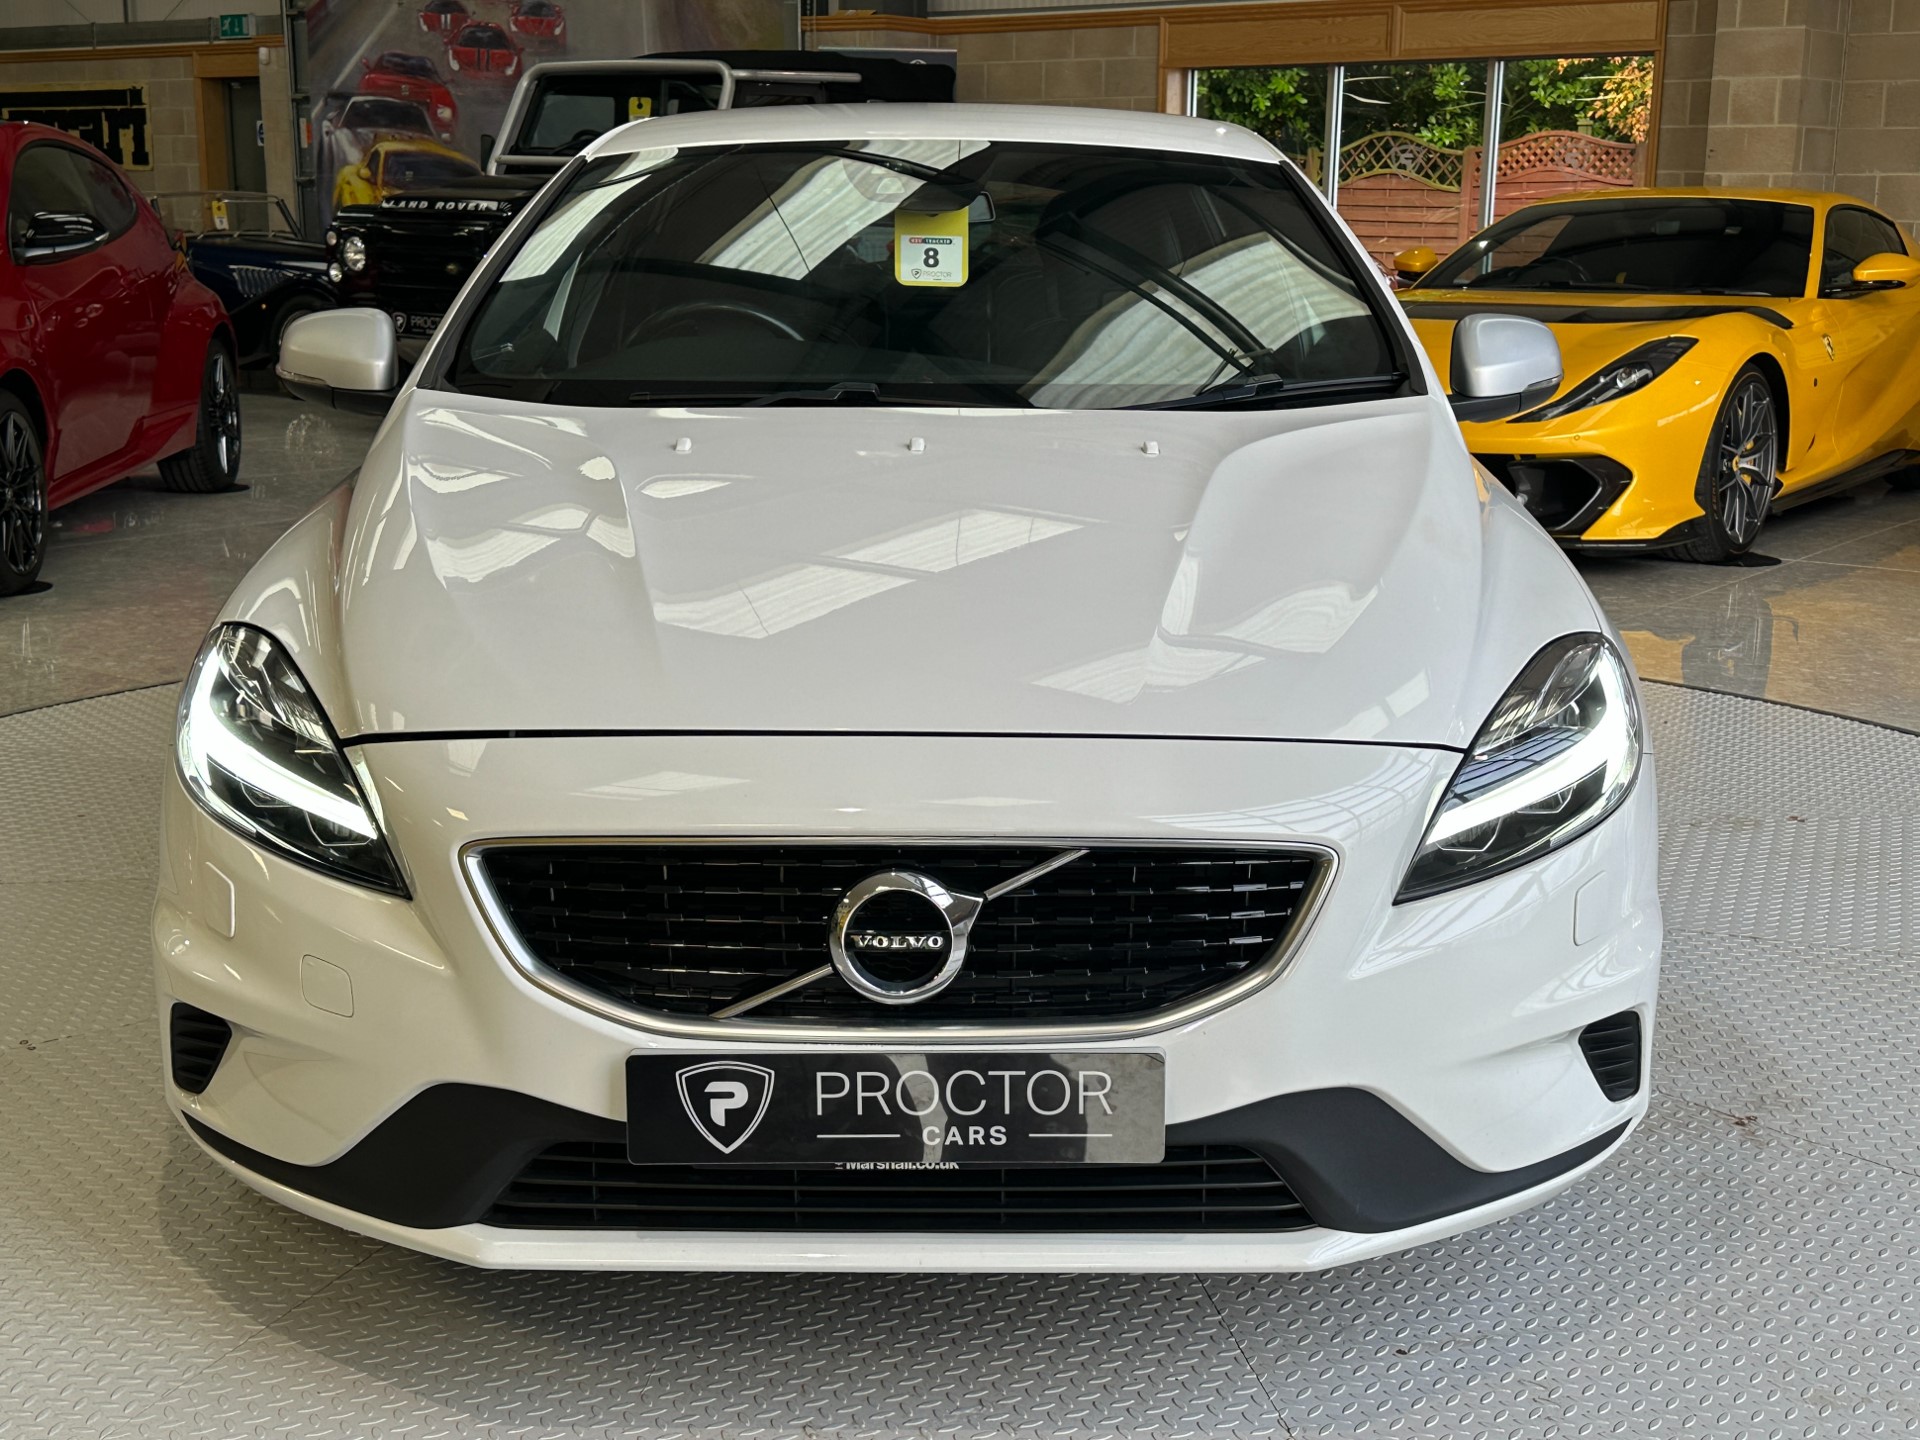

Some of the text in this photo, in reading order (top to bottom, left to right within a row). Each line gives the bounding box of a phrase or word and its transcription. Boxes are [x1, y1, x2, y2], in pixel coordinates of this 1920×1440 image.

[381, 200, 488, 211] LAND ROVER
[923, 247, 940, 268] 8
[850, 935, 944, 949] VOLVO
[815, 1069, 1114, 1116] PROCTOR
[922, 1125, 1008, 1146] CARS
